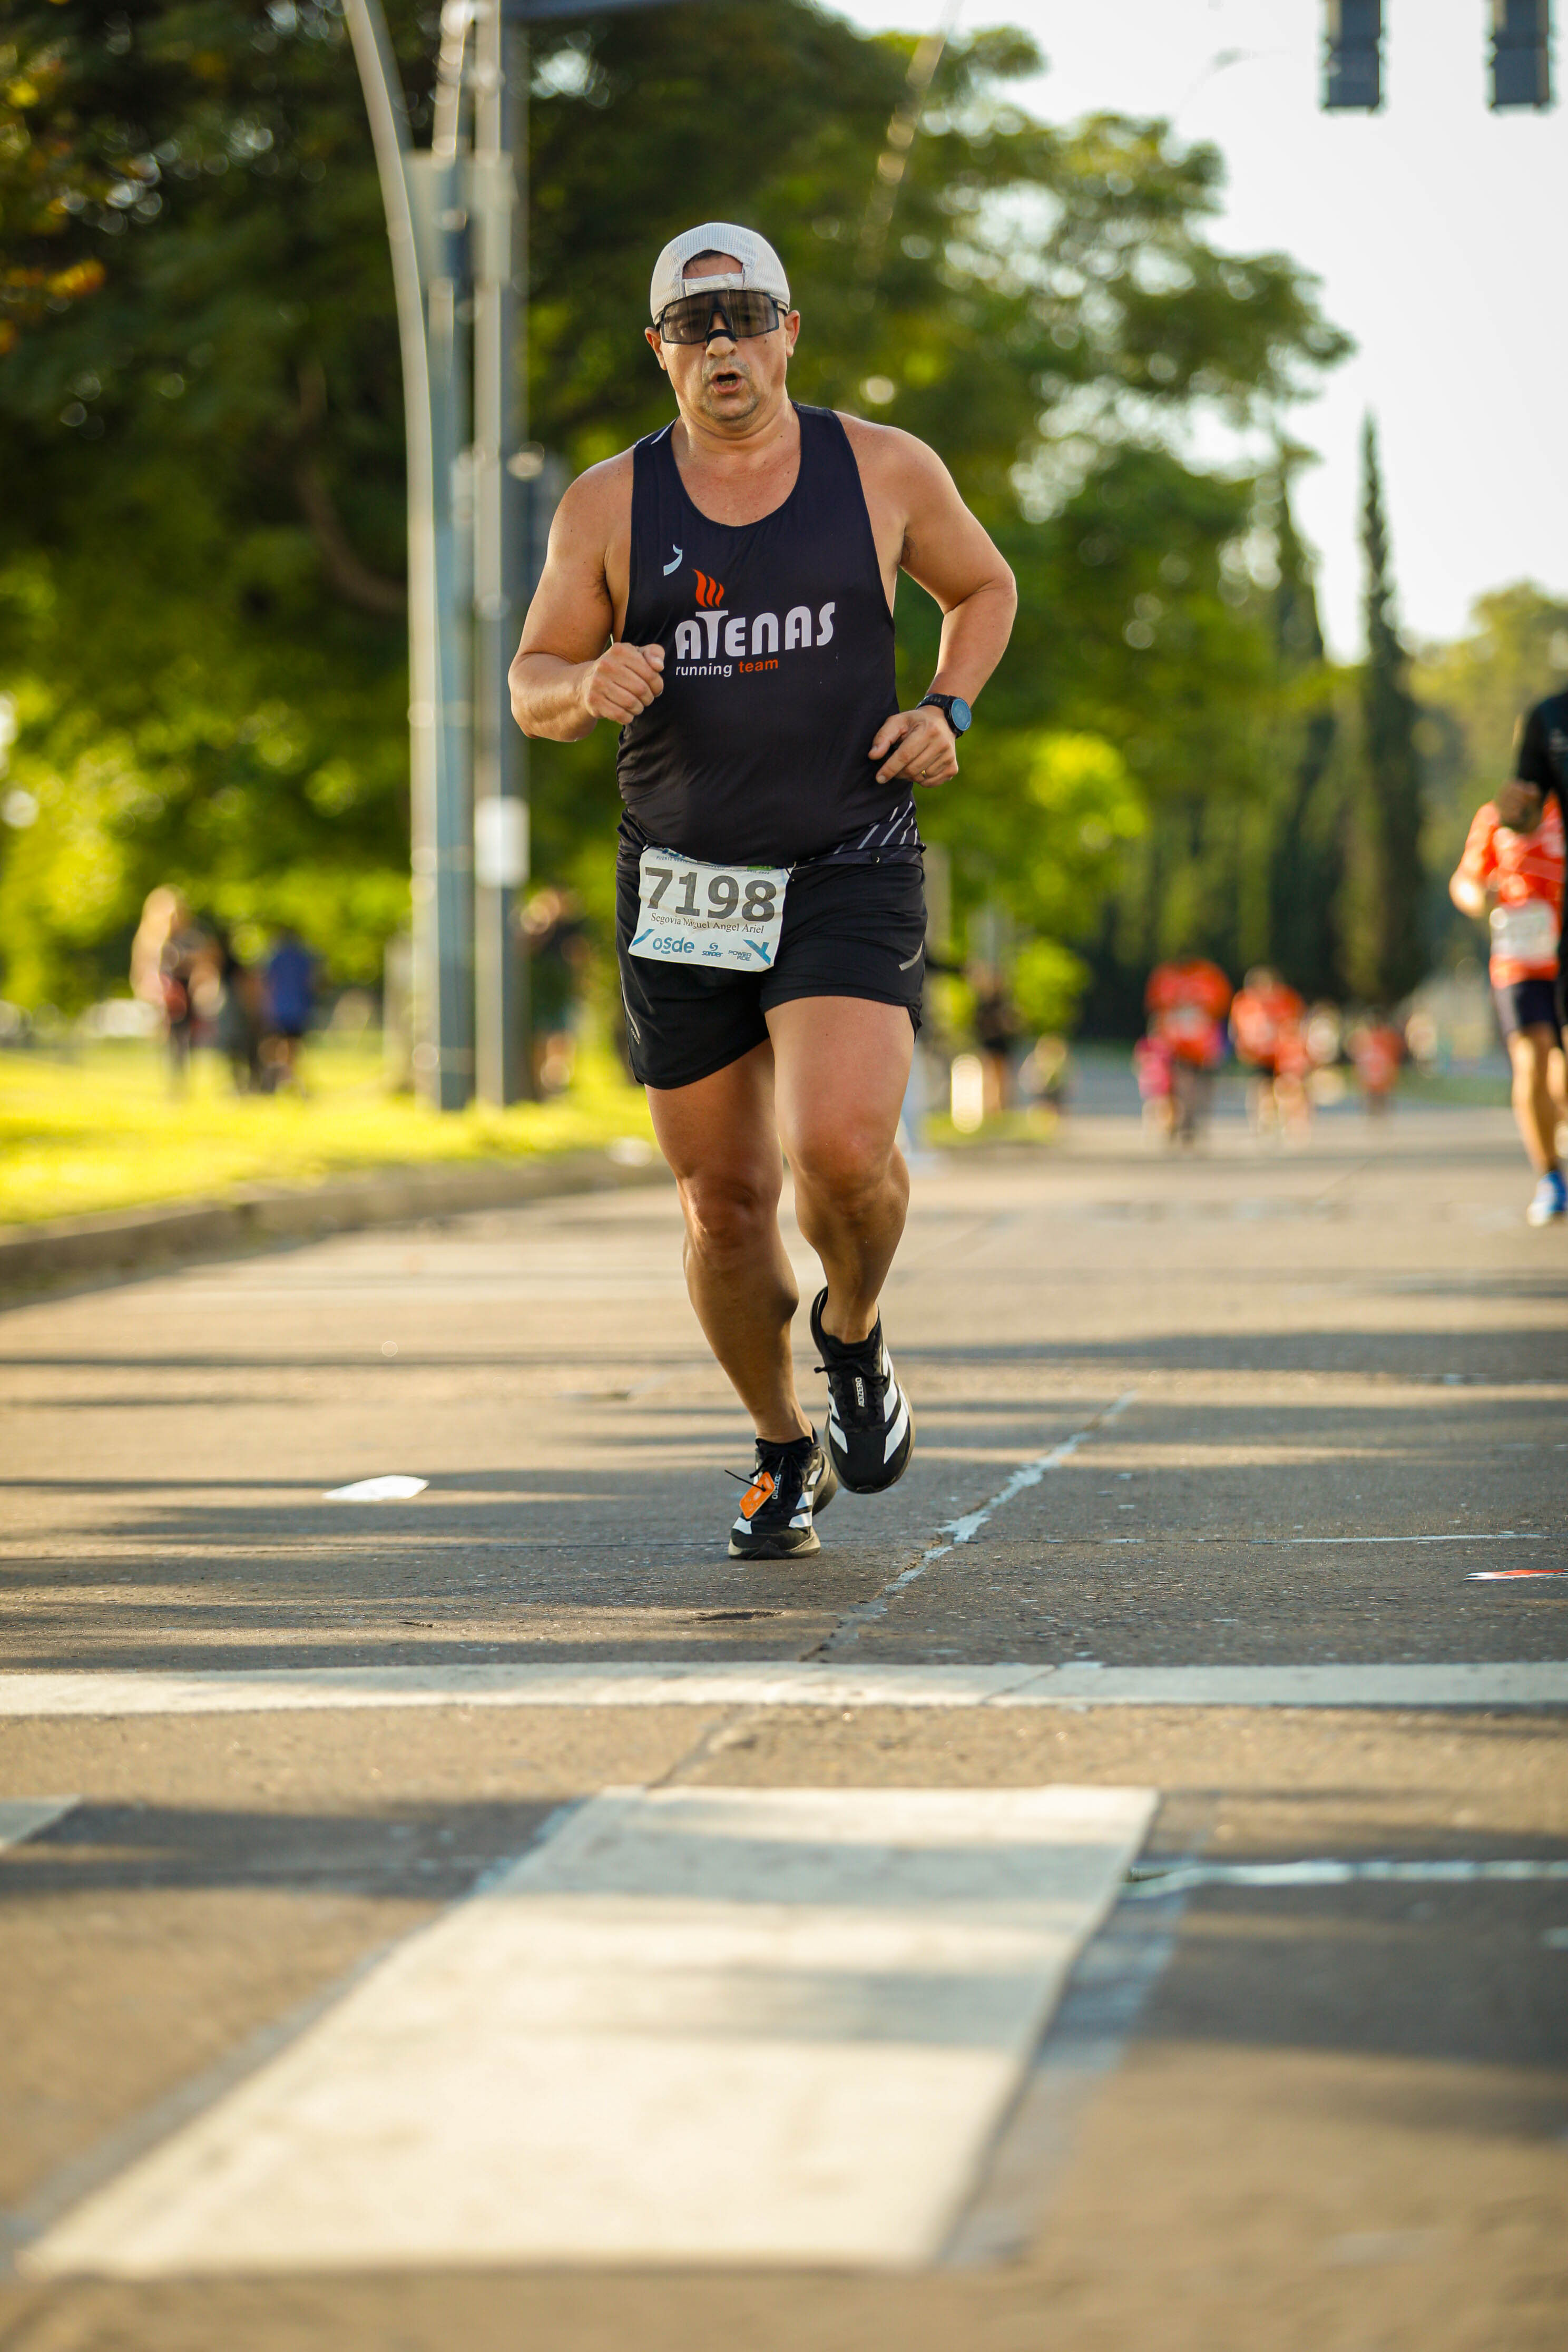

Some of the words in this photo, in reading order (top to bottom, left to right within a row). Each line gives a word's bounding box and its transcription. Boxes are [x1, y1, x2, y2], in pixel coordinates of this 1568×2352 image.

[674, 602, 836, 660] ATENAS
[675, 663, 732, 678] running
[739, 658, 778, 673] team
[644, 867, 777, 922] 7198
[651, 913, 681, 925] Segovia
[683, 917, 709, 929] Miguel
[713, 922, 739, 933] Angel
[742, 924, 765, 934] Ariel
[652, 937, 695, 954] osde
[855, 1377, 865, 1407] ADIZERO
